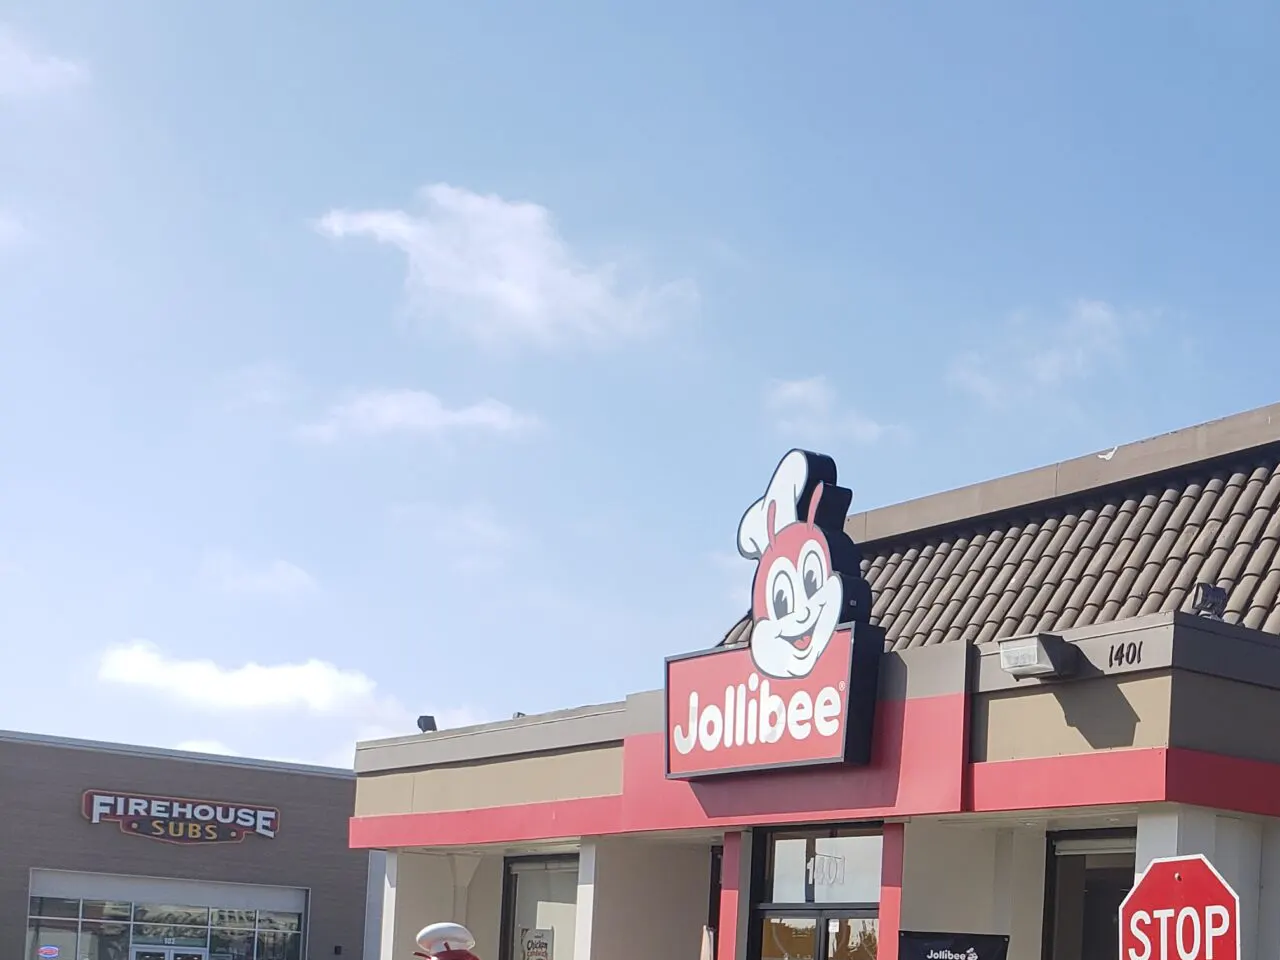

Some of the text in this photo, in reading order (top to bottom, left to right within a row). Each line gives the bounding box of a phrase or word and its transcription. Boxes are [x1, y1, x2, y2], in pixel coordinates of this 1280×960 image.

[1108, 640, 1143, 668] 1401
[673, 672, 842, 755] Jollibee
[91, 794, 276, 838] FIREHOUSE
[151, 820, 218, 840] SUBS
[926, 949, 966, 960] Jollibee
